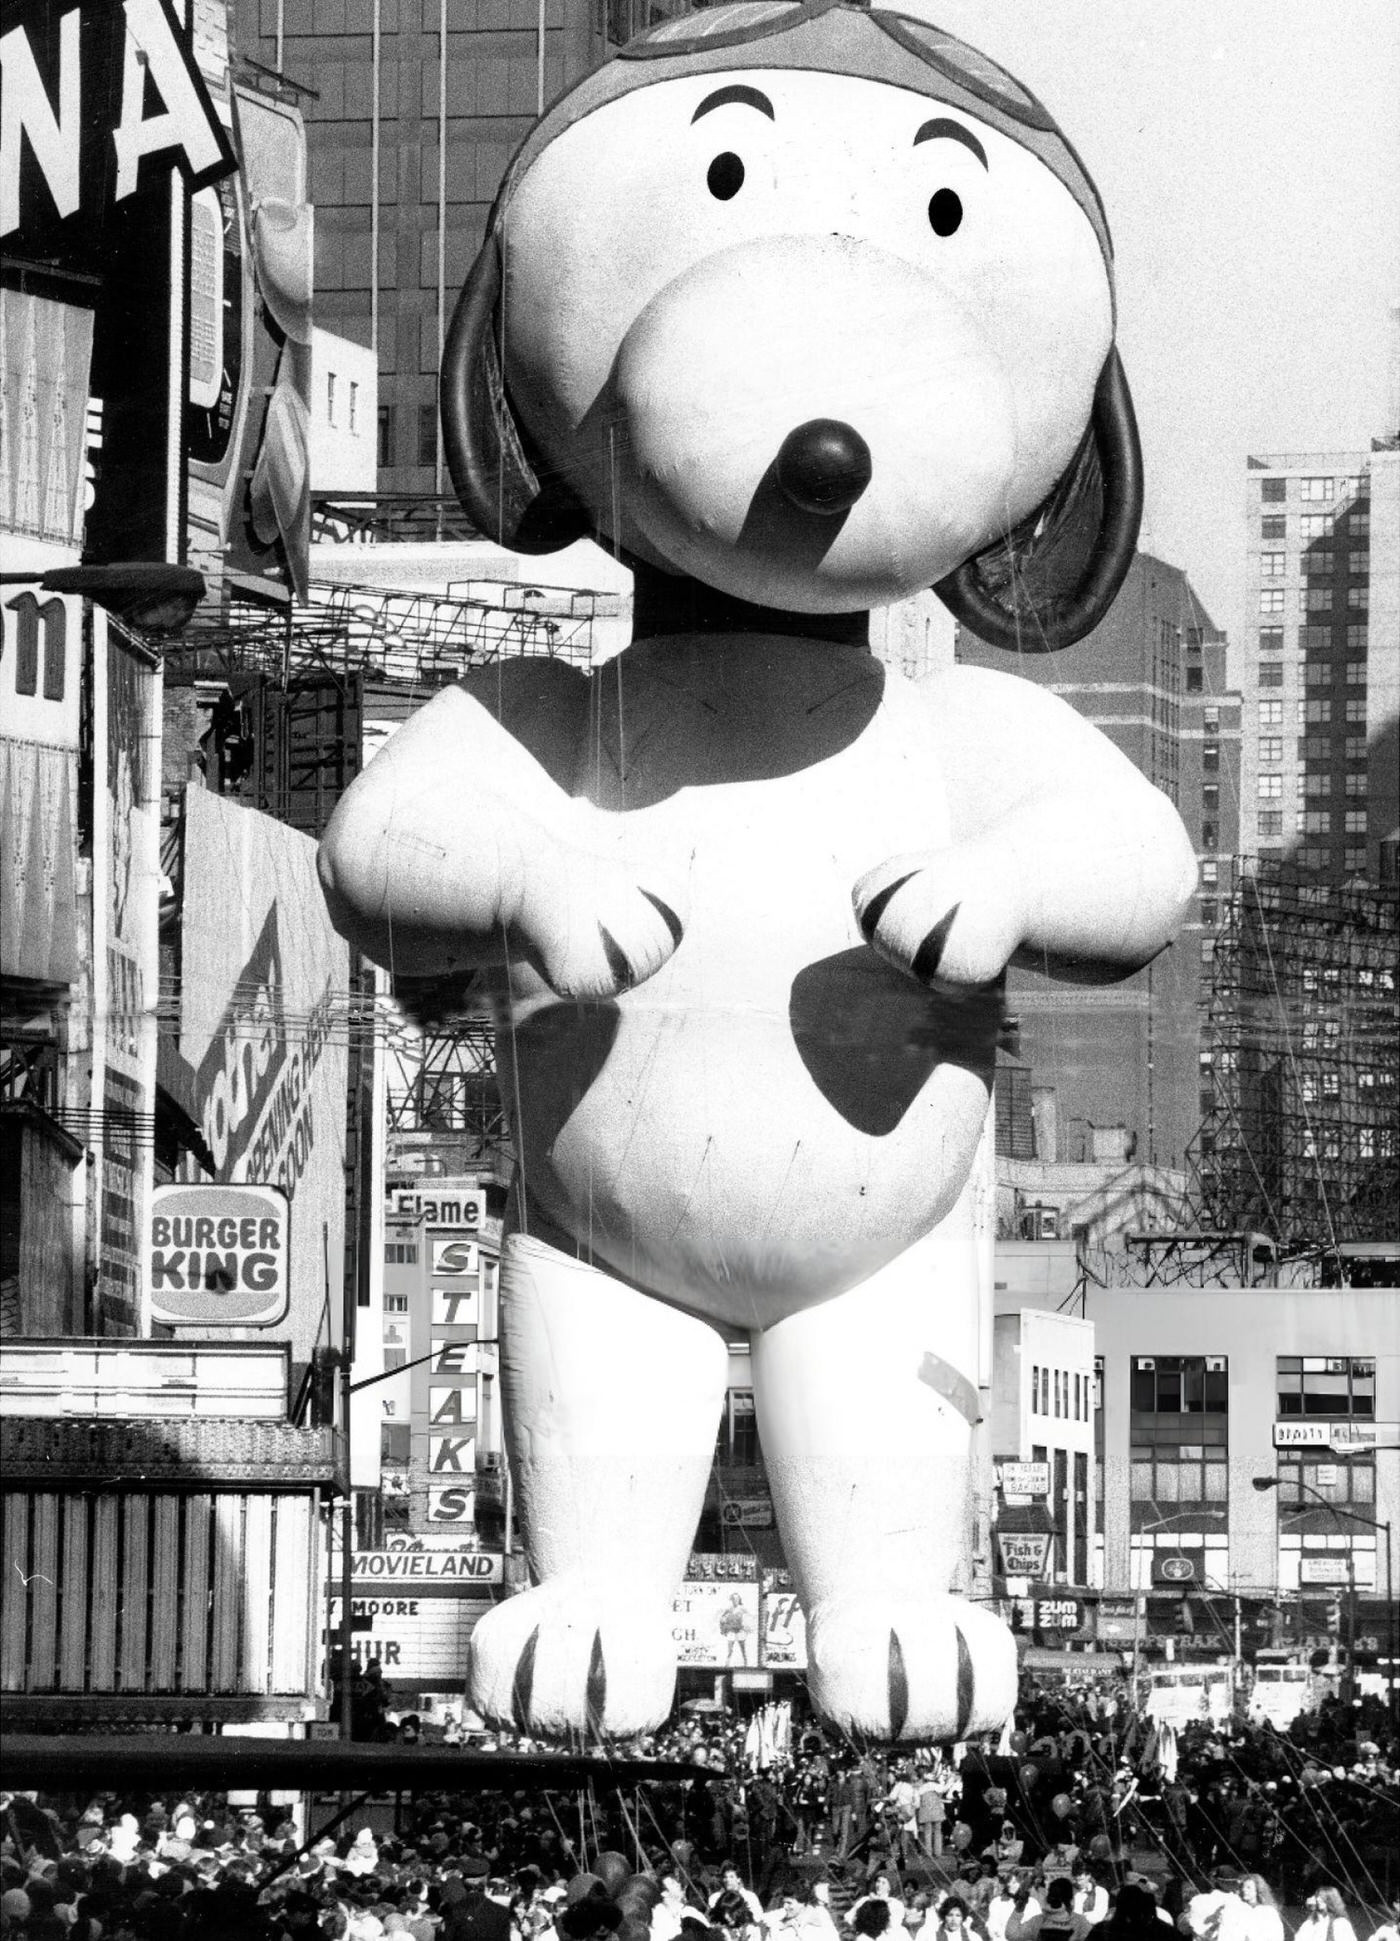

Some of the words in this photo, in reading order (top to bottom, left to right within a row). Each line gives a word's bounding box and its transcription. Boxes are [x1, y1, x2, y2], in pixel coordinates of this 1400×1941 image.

[152, 1217, 281, 1250] BURGER
[152, 1252, 279, 1291] KING
[432, 1243, 472, 1520] STEAKS
[1002, 1541, 1032, 1556] Fish
[1033, 1545, 1043, 1556] &
[352, 1555, 494, 1576] MOVIELAND
[1006, 1556, 1041, 1571] Chips
[352, 1600, 420, 1616] MOORE
